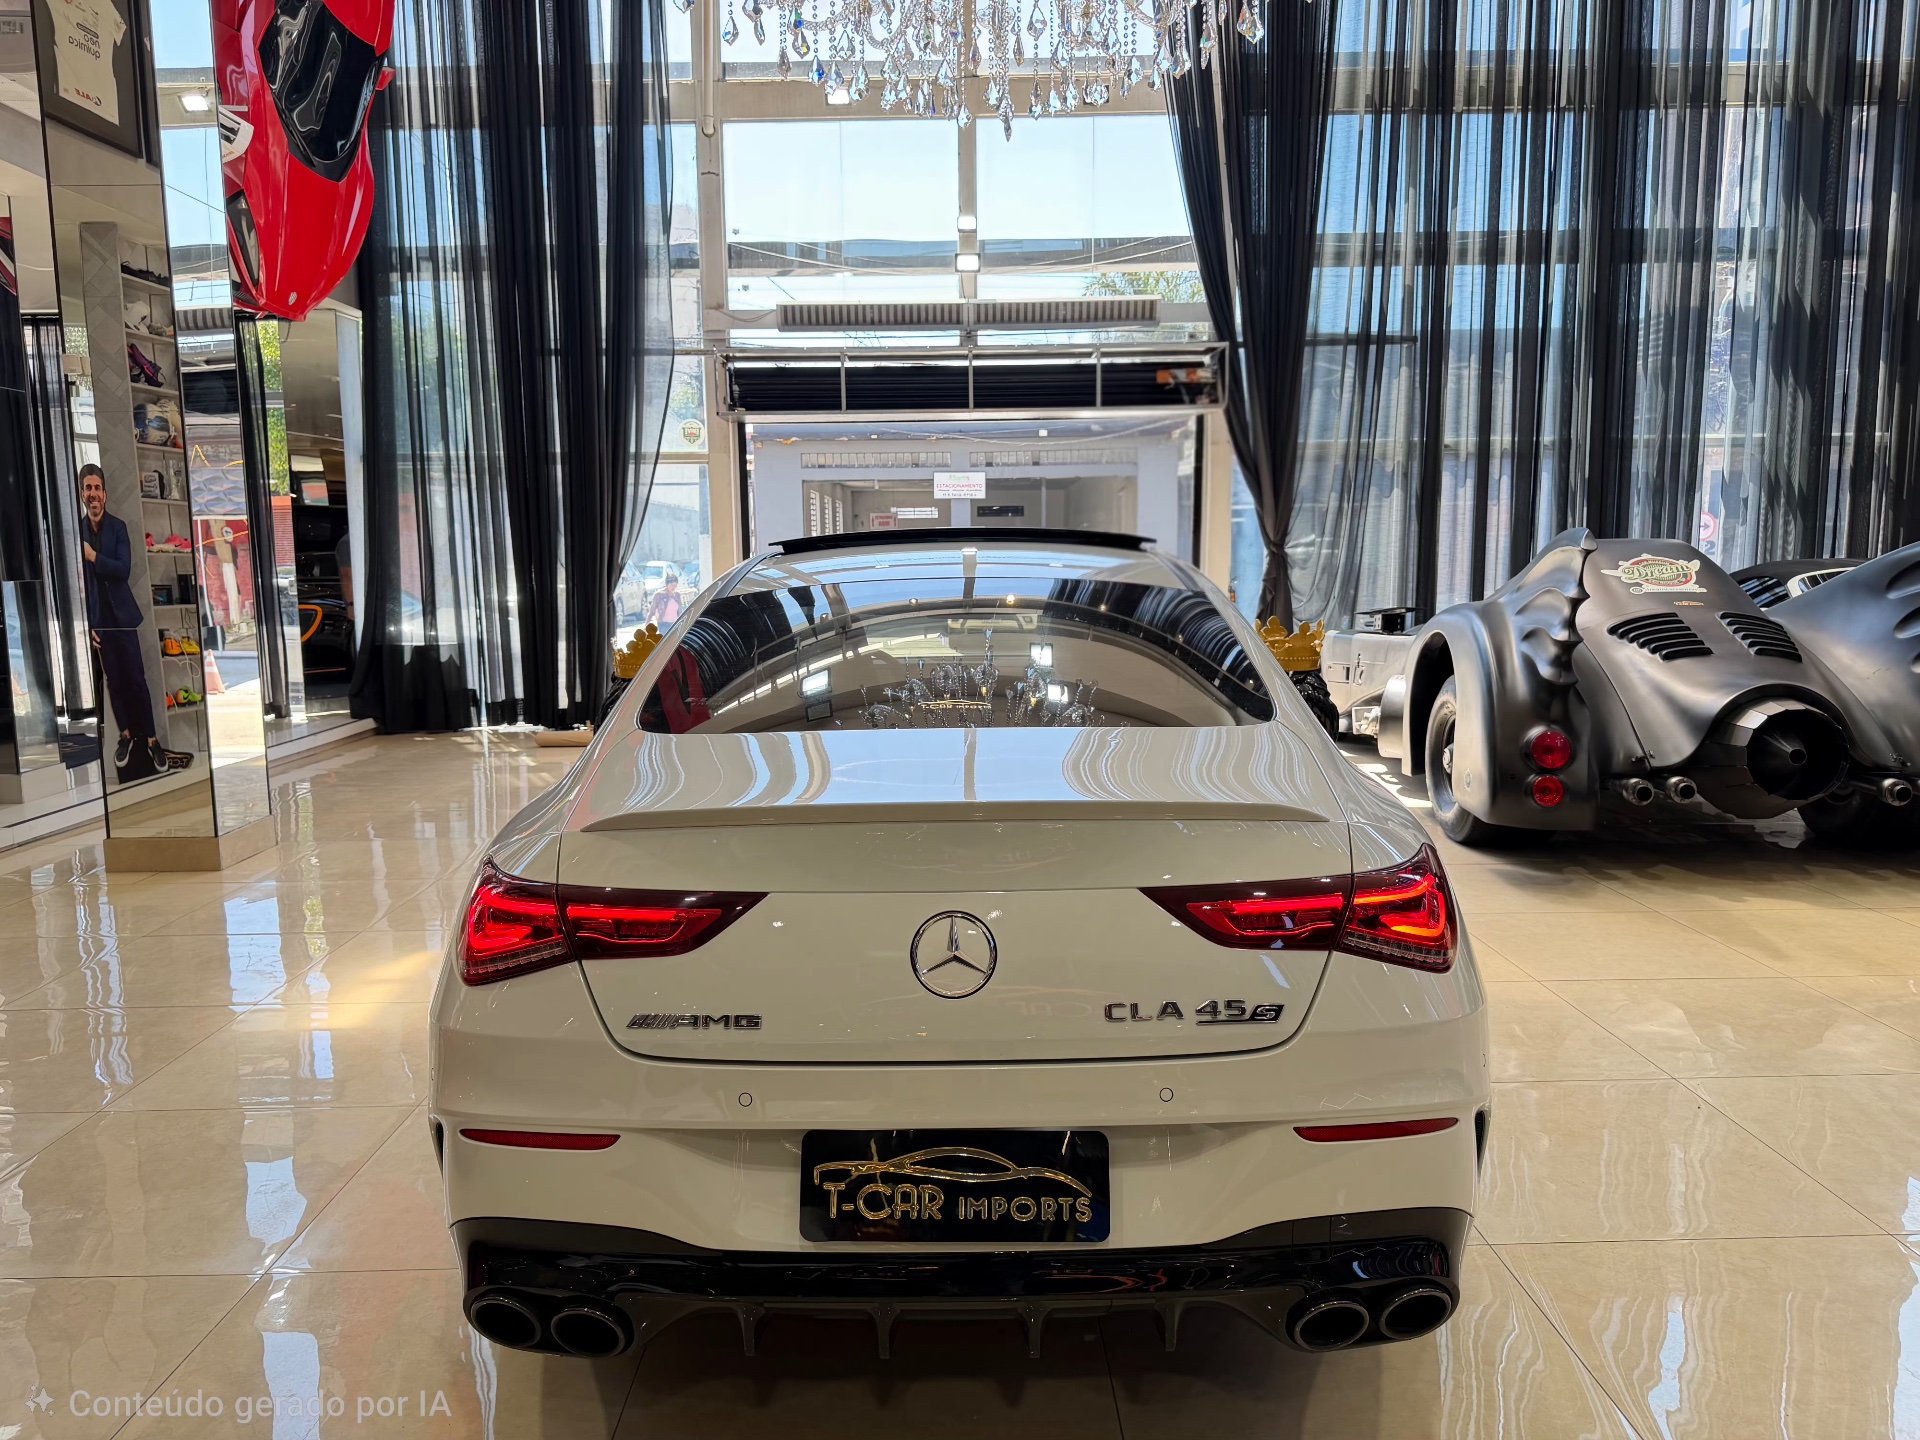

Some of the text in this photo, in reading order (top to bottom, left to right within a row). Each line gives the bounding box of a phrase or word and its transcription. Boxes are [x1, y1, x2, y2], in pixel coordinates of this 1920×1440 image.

[1622, 563, 1692, 579] Dream
[1104, 1000, 1185, 1021] CLA
[668, 1013, 763, 1030] AMG
[823, 1182, 1093, 1222] T-CAR IMPORTS
